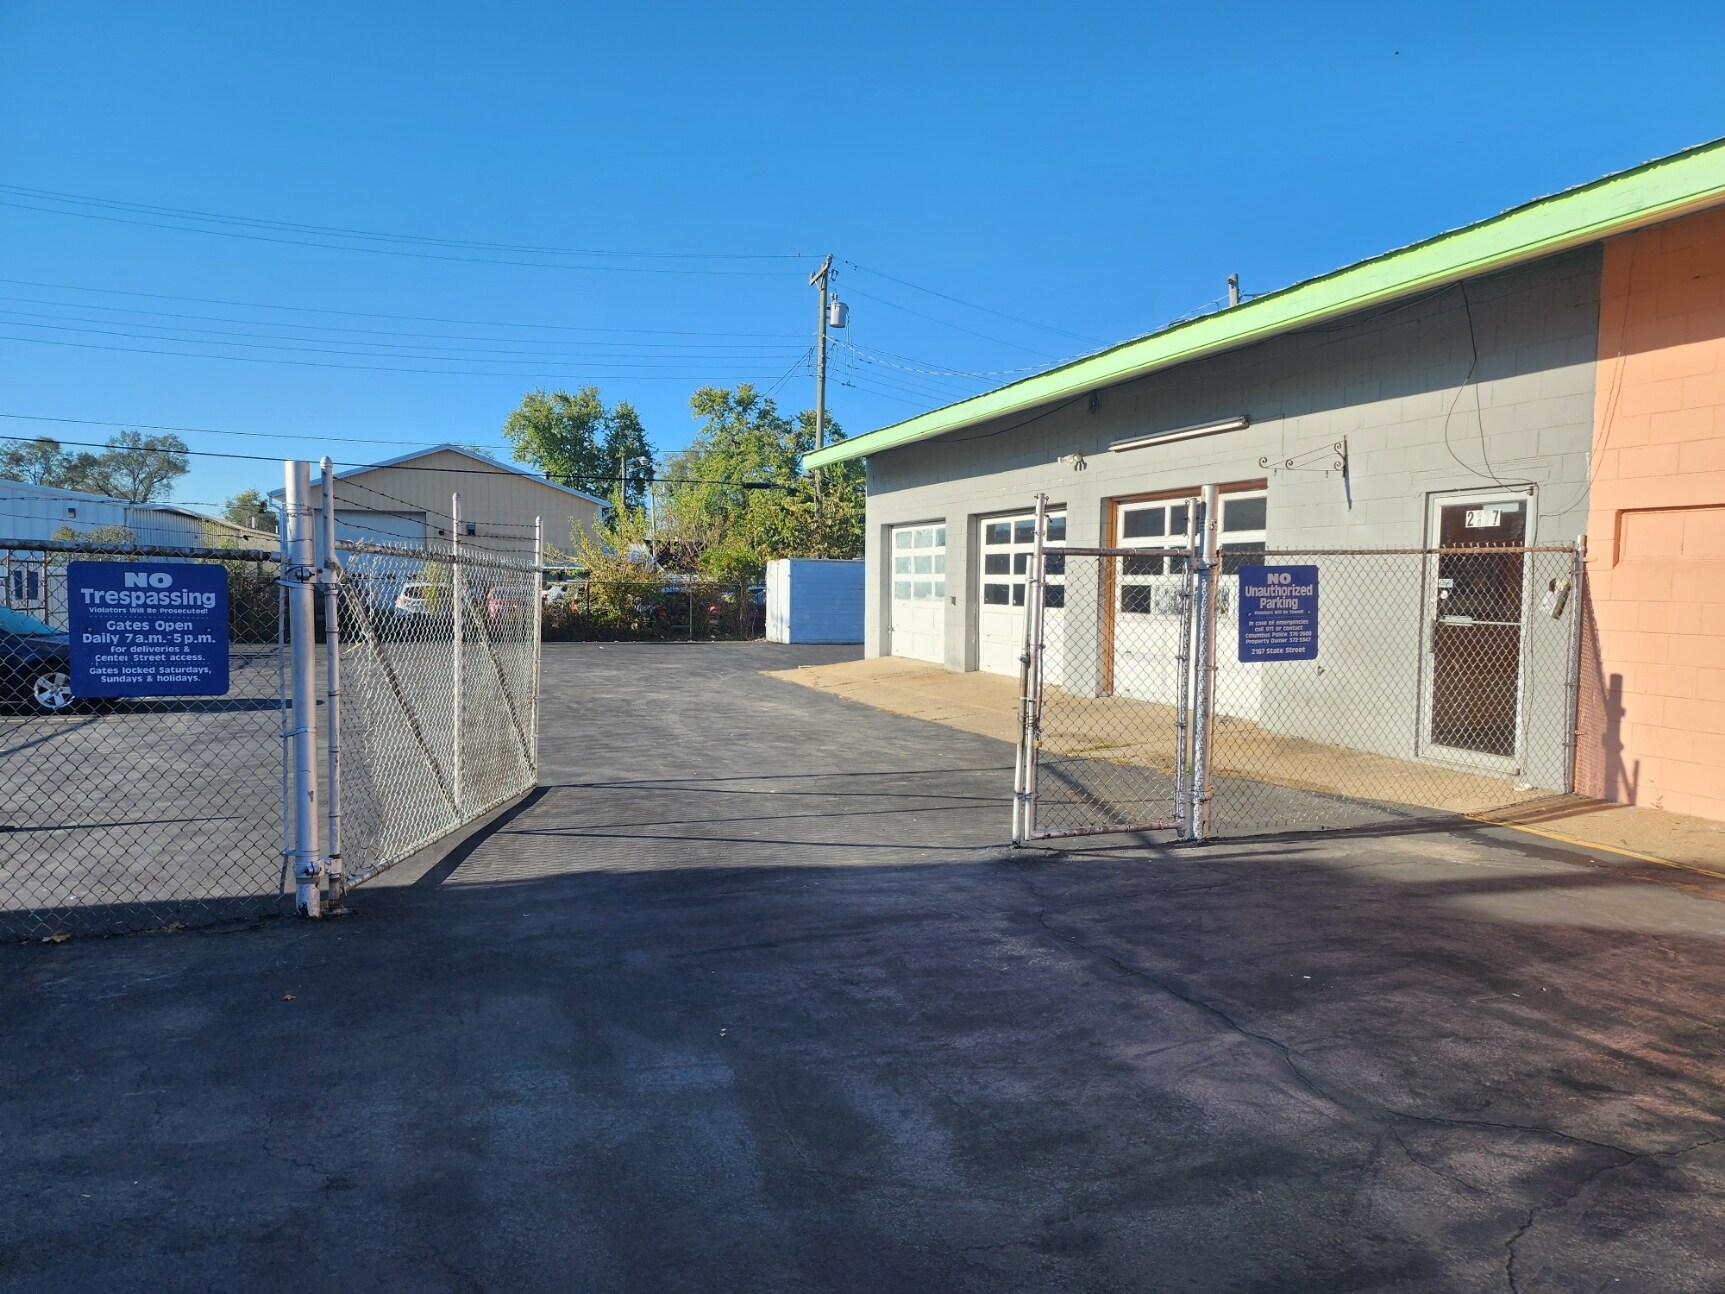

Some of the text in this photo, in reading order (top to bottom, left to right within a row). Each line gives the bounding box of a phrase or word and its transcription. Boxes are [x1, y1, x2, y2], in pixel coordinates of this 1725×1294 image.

[124, 572, 172, 588] NO
[1267, 573, 1291, 584] NO
[1245, 584, 1312, 597] Unauthorized
[80, 588, 216, 608] Trespassing
[1260, 597, 1298, 610] Parking
[106, 620, 192, 632] Gates Open
[82, 633, 119, 644] Daily
[159, 666, 212, 674] Saturdays,
[157, 674, 201, 682] holidays.
